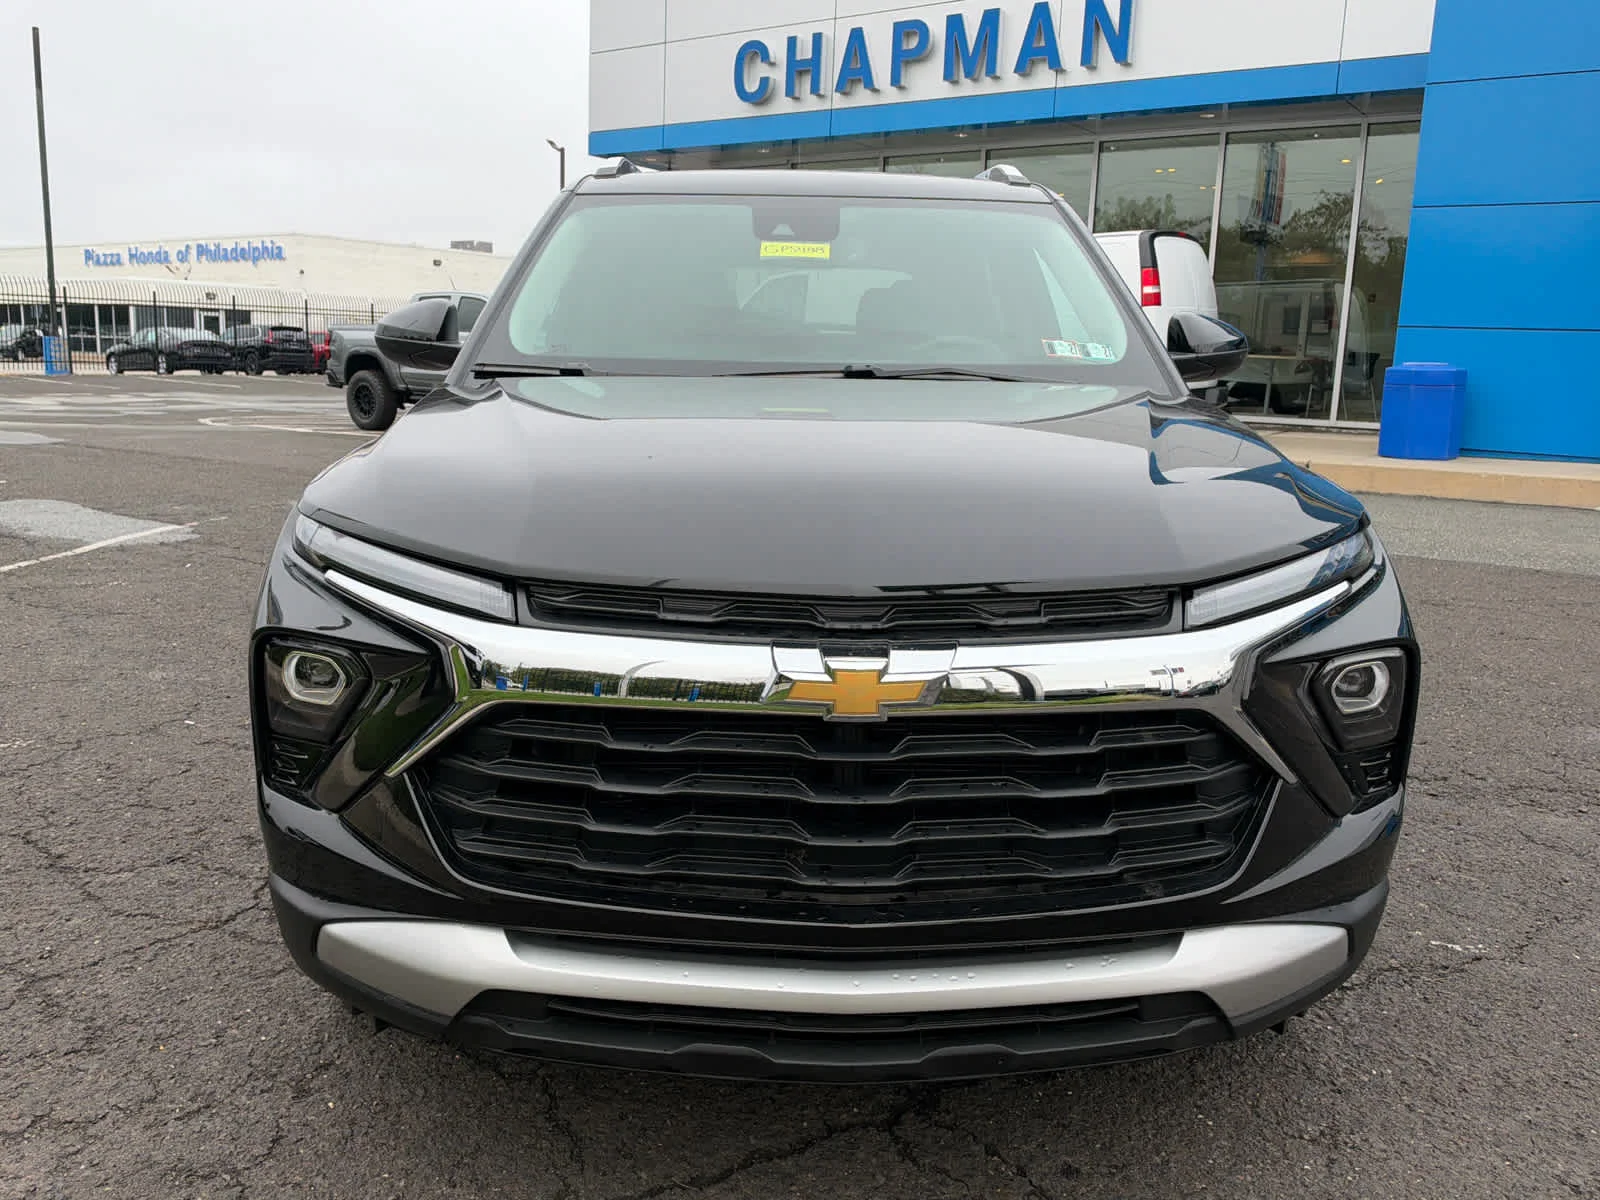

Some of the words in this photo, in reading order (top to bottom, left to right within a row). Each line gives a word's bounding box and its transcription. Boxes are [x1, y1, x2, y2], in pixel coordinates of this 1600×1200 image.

[733, 0, 1133, 103] CHAPMAN
[83, 248, 122, 266] Piazza
[127, 246, 170, 264] Honda
[176, 244, 190, 262] of
[195, 240, 285, 265] Philadelphia
